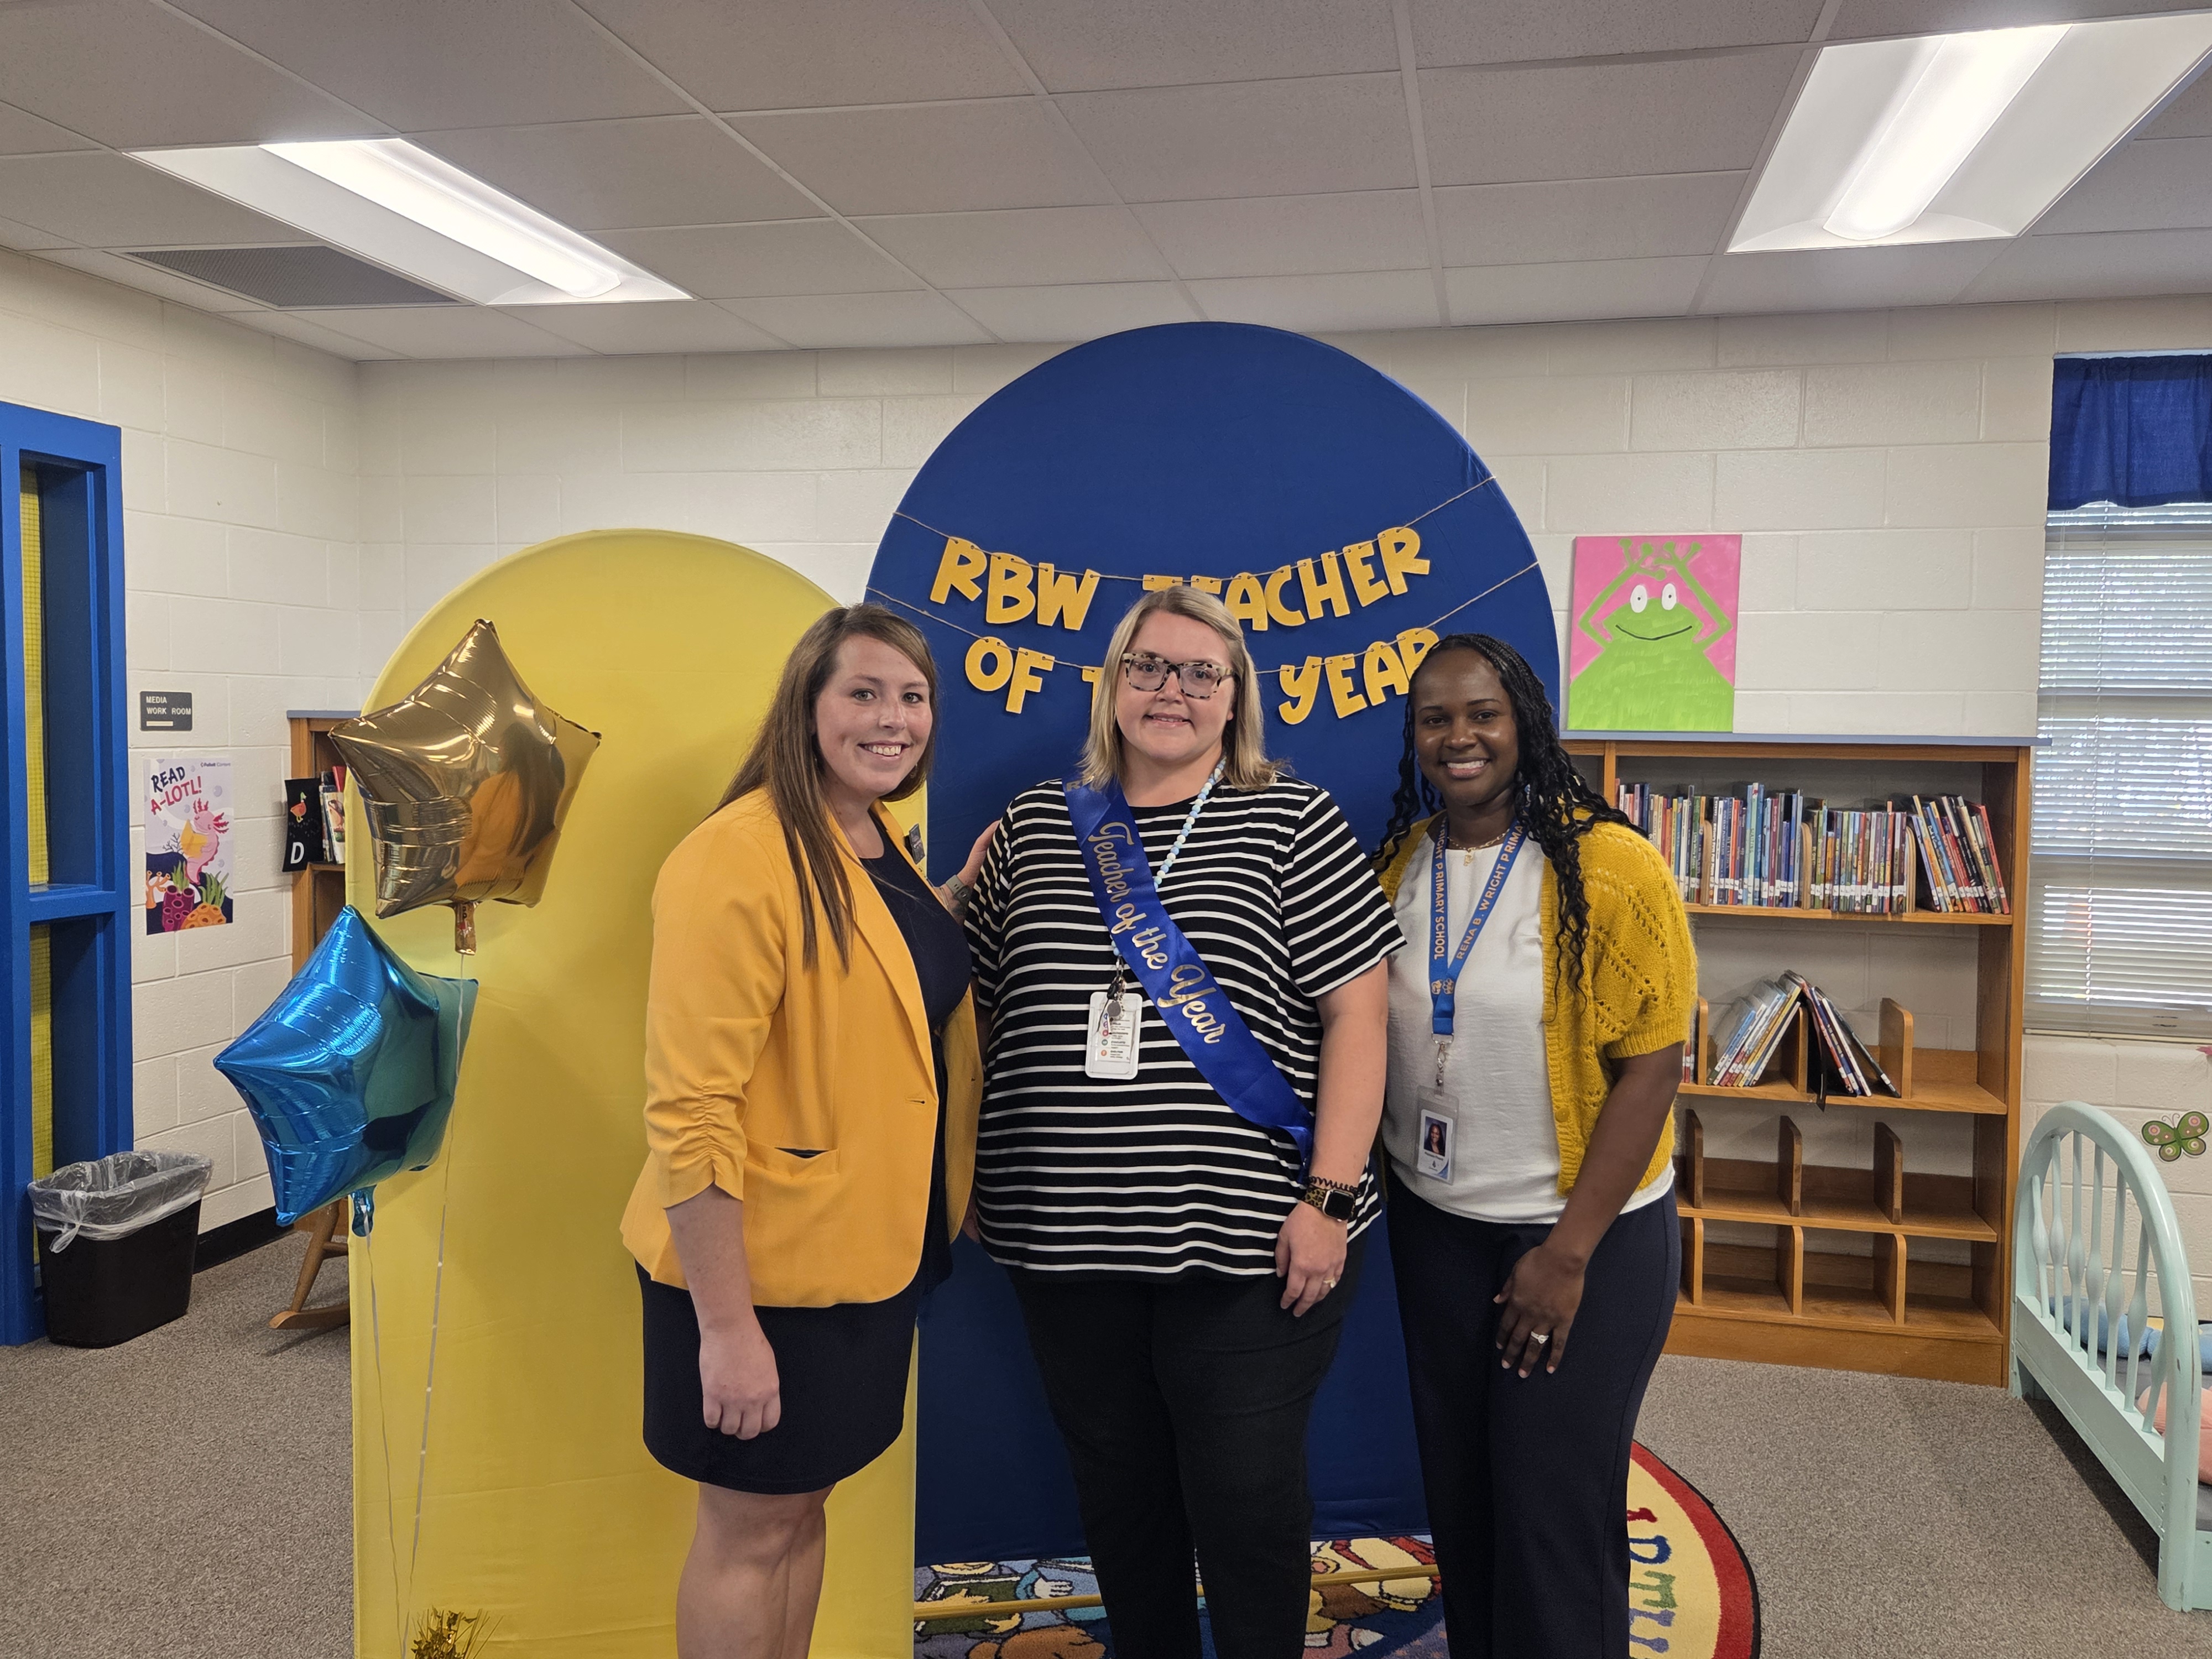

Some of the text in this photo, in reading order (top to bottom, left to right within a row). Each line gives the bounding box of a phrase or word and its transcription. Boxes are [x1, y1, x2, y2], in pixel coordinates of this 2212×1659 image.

[930, 527, 1430, 630] RBW ACHER
[965, 637, 1054, 713] OF
[146, 696, 168, 704] MEDIA
[171, 707, 191, 716] ROOM
[150, 766, 186, 793] READ
[150, 776, 202, 815] A-LOTL!
[290, 841, 305, 864] D
[1435, 862, 1444, 914] PRIMARY
[1456, 928, 1478, 959] RENA
[1479, 863, 1506, 911] WRIGHT
[1500, 821, 1524, 862] PRIMA
[1088, 821, 1226, 1044] Teacher of the Year
[1434, 916, 1446, 960] SCHOOL
